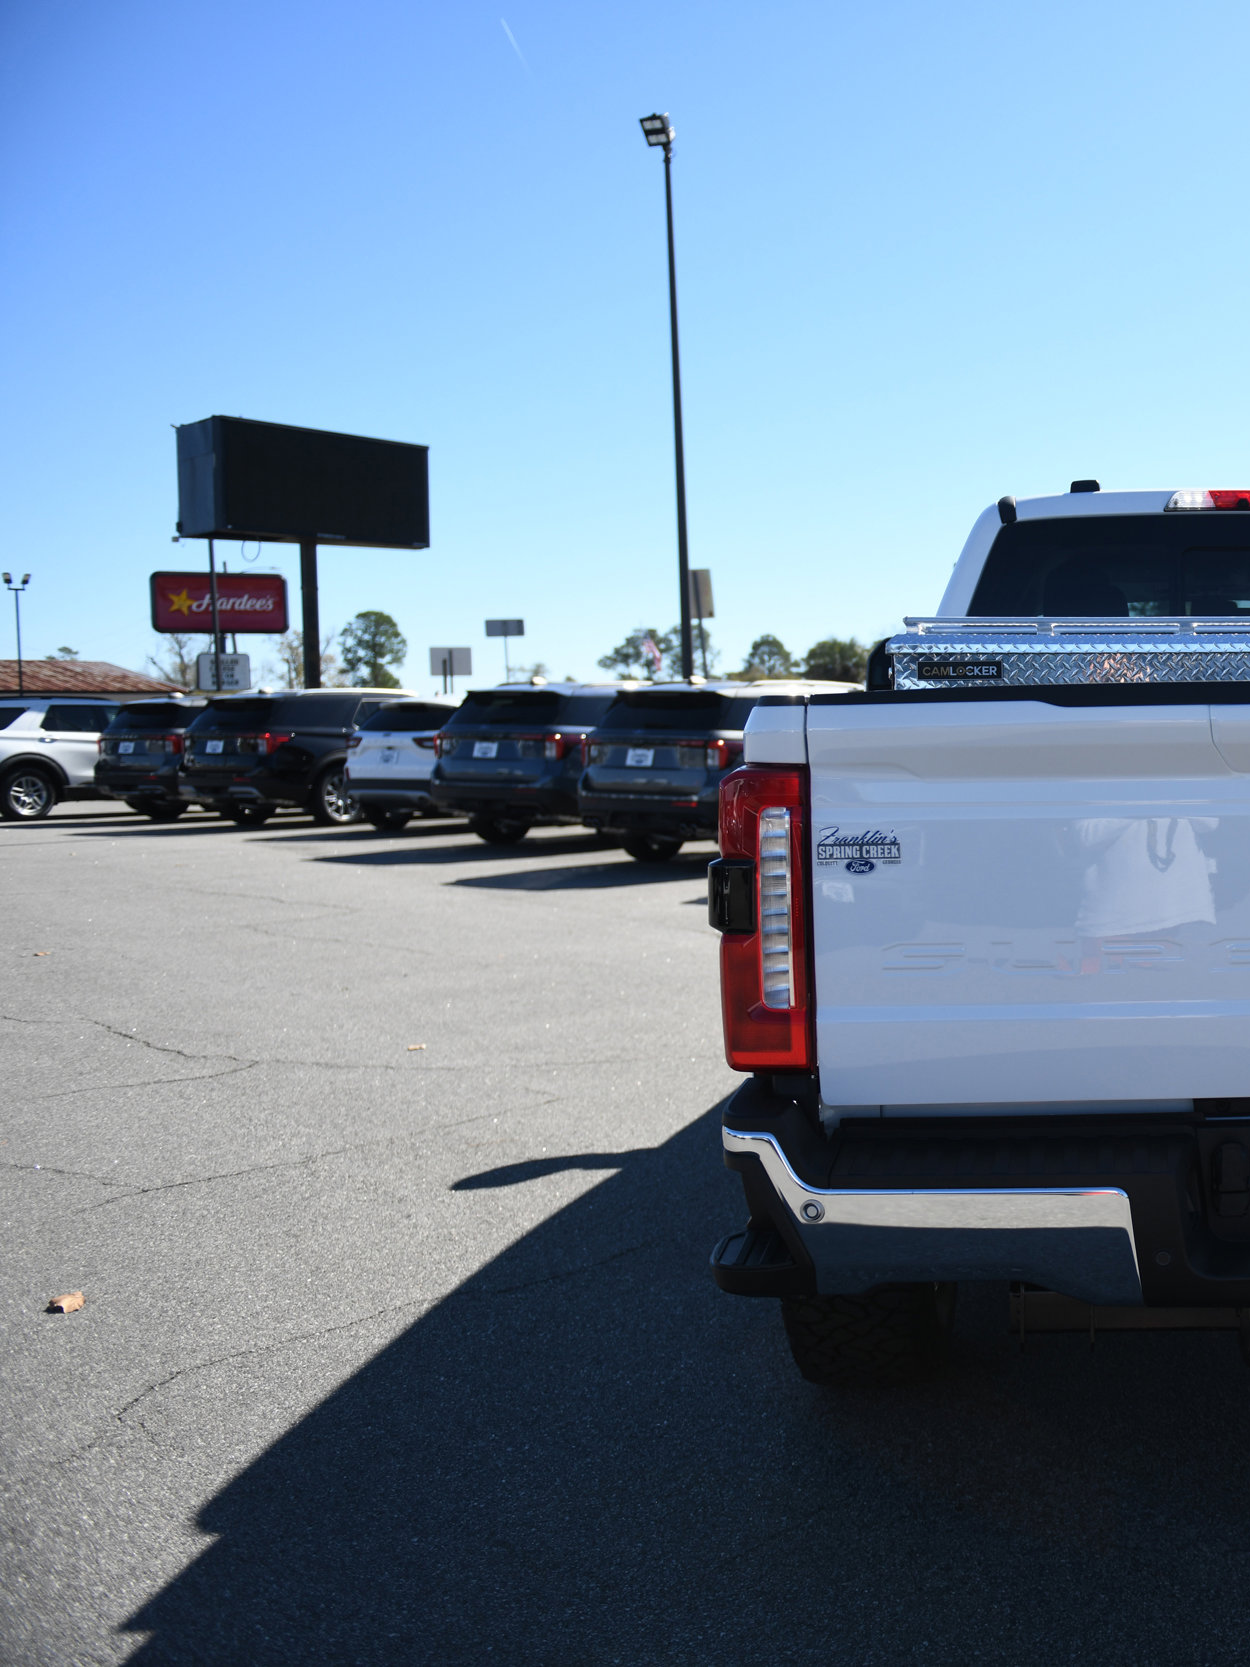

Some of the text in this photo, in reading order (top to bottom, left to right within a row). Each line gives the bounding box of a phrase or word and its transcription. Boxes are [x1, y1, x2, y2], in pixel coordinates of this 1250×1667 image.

[922, 666, 997, 676] CAMLOCKER
[819, 826, 899, 845] Franklin's
[818, 844, 900, 859] SPRING CREEK
[850, 860, 870, 872] Ford
